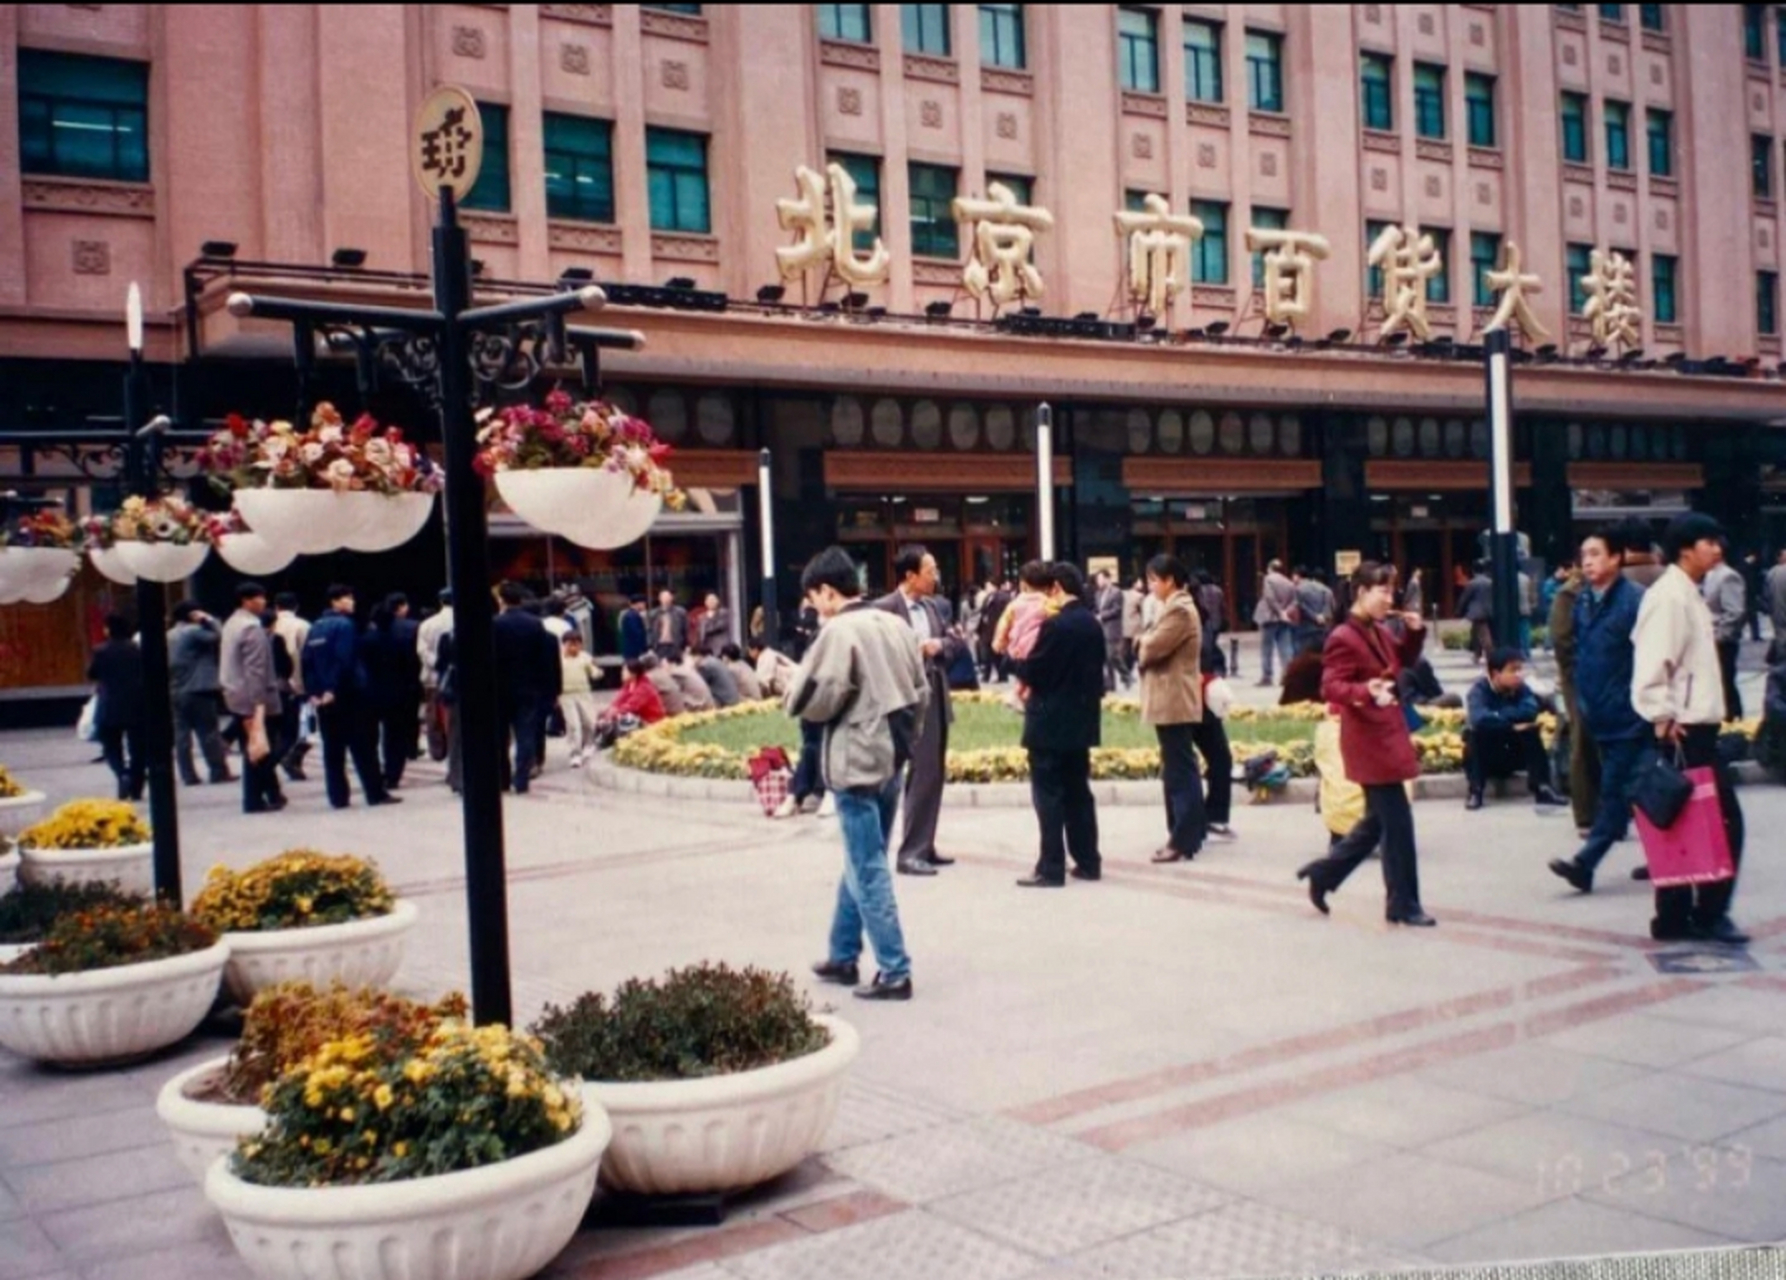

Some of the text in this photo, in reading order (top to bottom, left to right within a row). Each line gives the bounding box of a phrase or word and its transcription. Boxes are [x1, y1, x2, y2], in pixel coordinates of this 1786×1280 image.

[775, 162, 1643, 349] 北京市百货大楼
